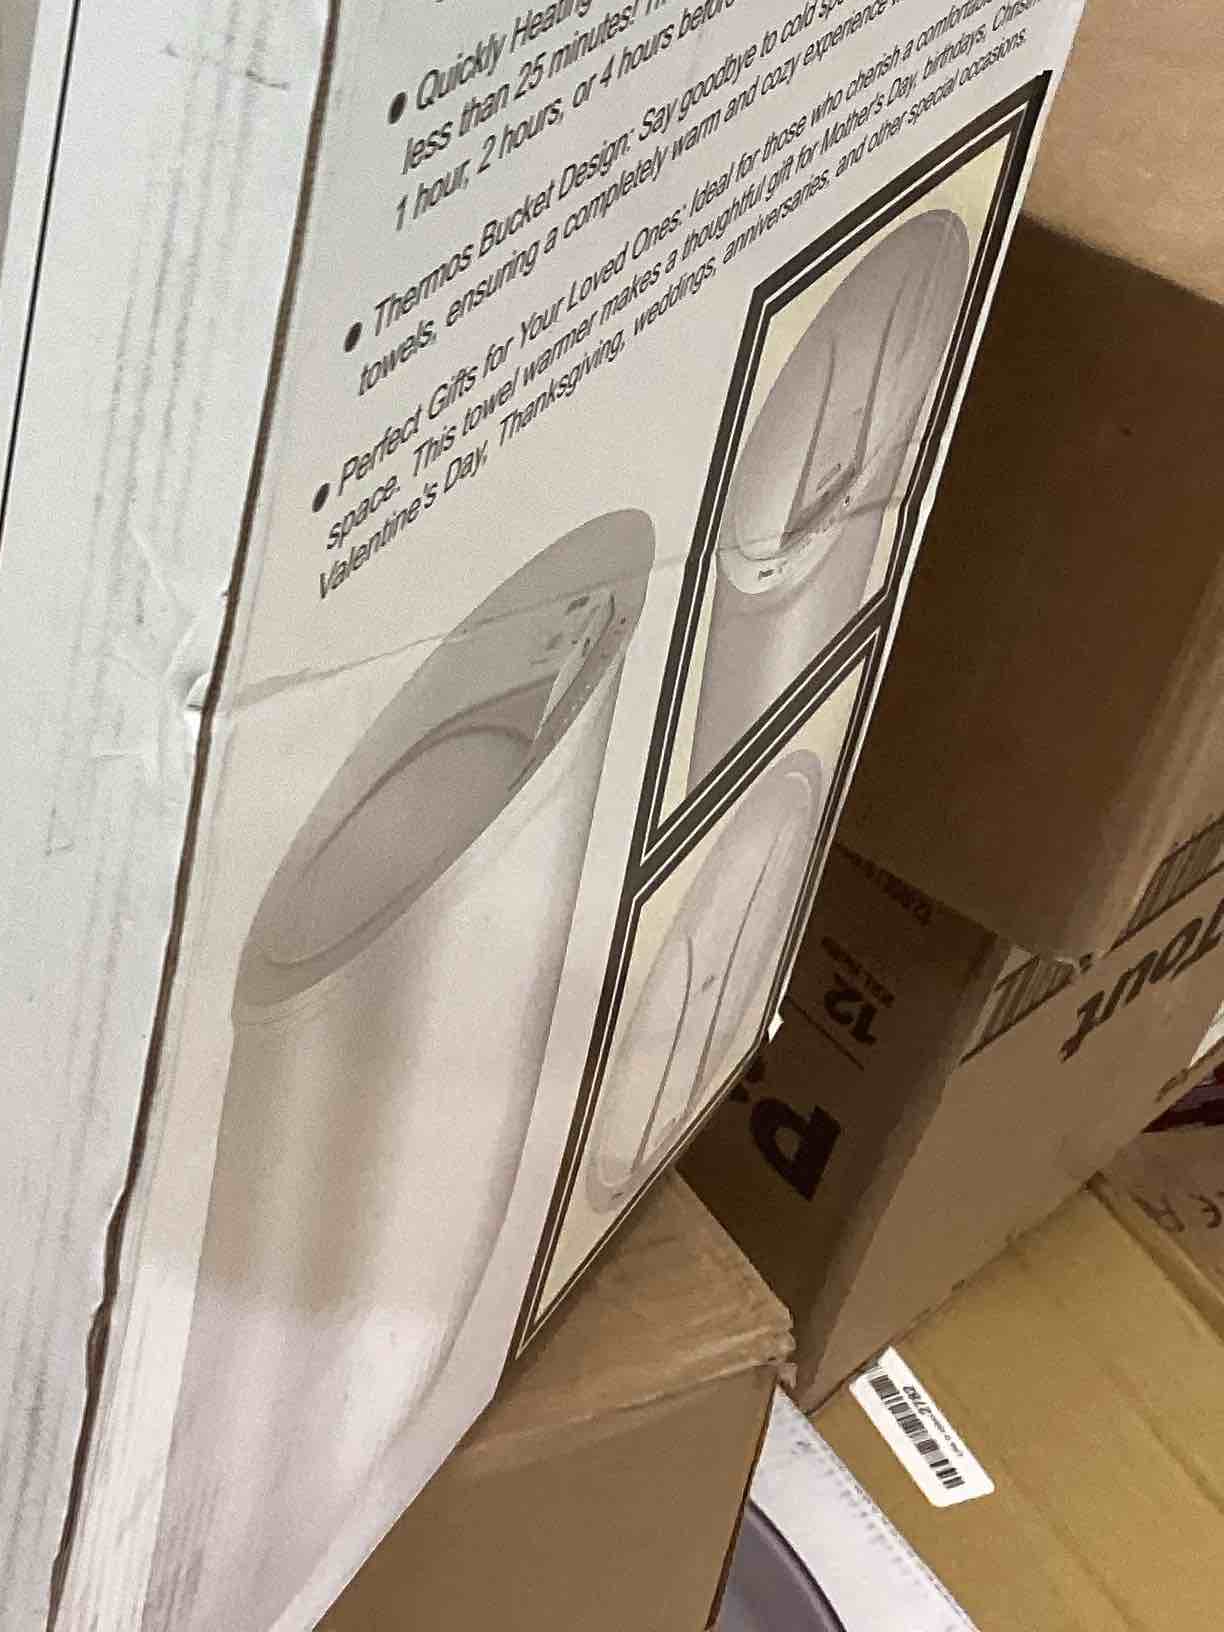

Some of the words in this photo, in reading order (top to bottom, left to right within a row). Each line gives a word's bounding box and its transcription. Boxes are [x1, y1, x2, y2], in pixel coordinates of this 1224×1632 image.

[374, 243, 474, 336] Thermos
[477, 179, 555, 258] Bucket
[557, 127, 634, 201] Design:
[638, 97, 678, 141] Say
[676, 43, 757, 122] goodbye
[759, 29, 777, 57] to
[396, 194, 408, 230] 1
[412, 158, 471, 219] hour,
[476, 134, 497, 174] 2
[497, 96, 564, 159] hours,
[571, 73, 597, 108] or
[599, 54, 616, 88] 4
[616, 23, 674, 79] hours
